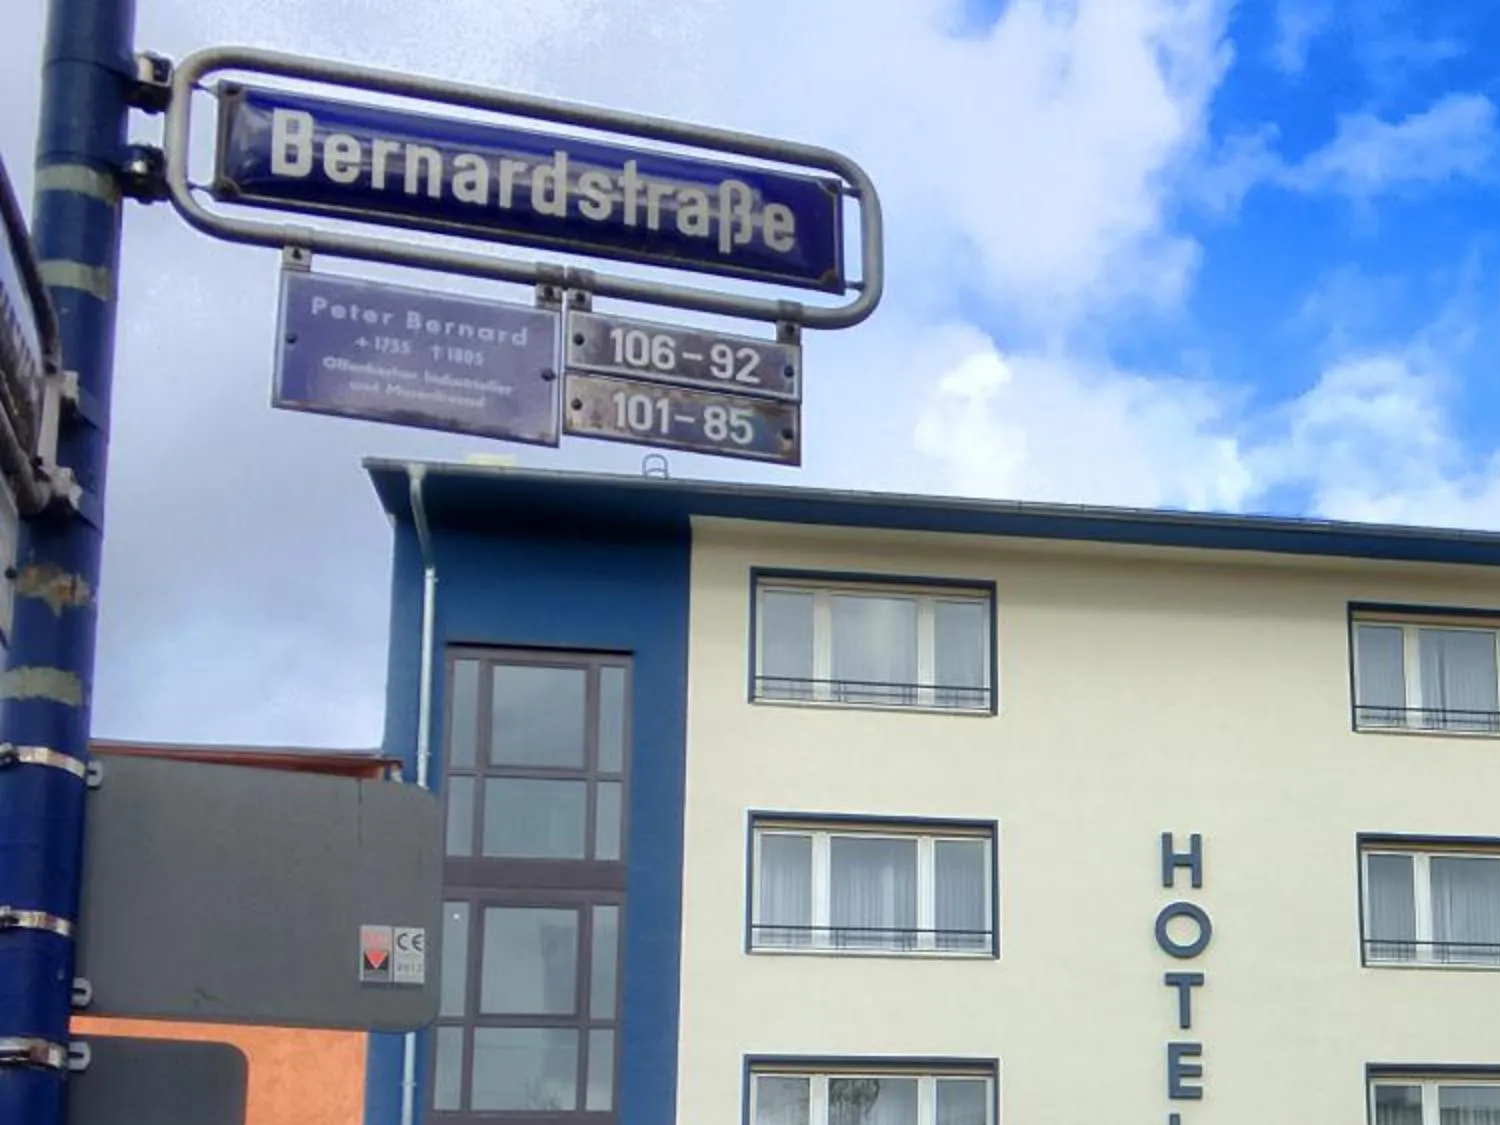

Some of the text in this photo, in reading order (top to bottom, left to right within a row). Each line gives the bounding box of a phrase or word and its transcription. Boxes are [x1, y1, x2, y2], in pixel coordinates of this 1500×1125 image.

[269, 107, 797, 255] Bernardstraße
[311, 296, 528, 347] Peter Bernard
